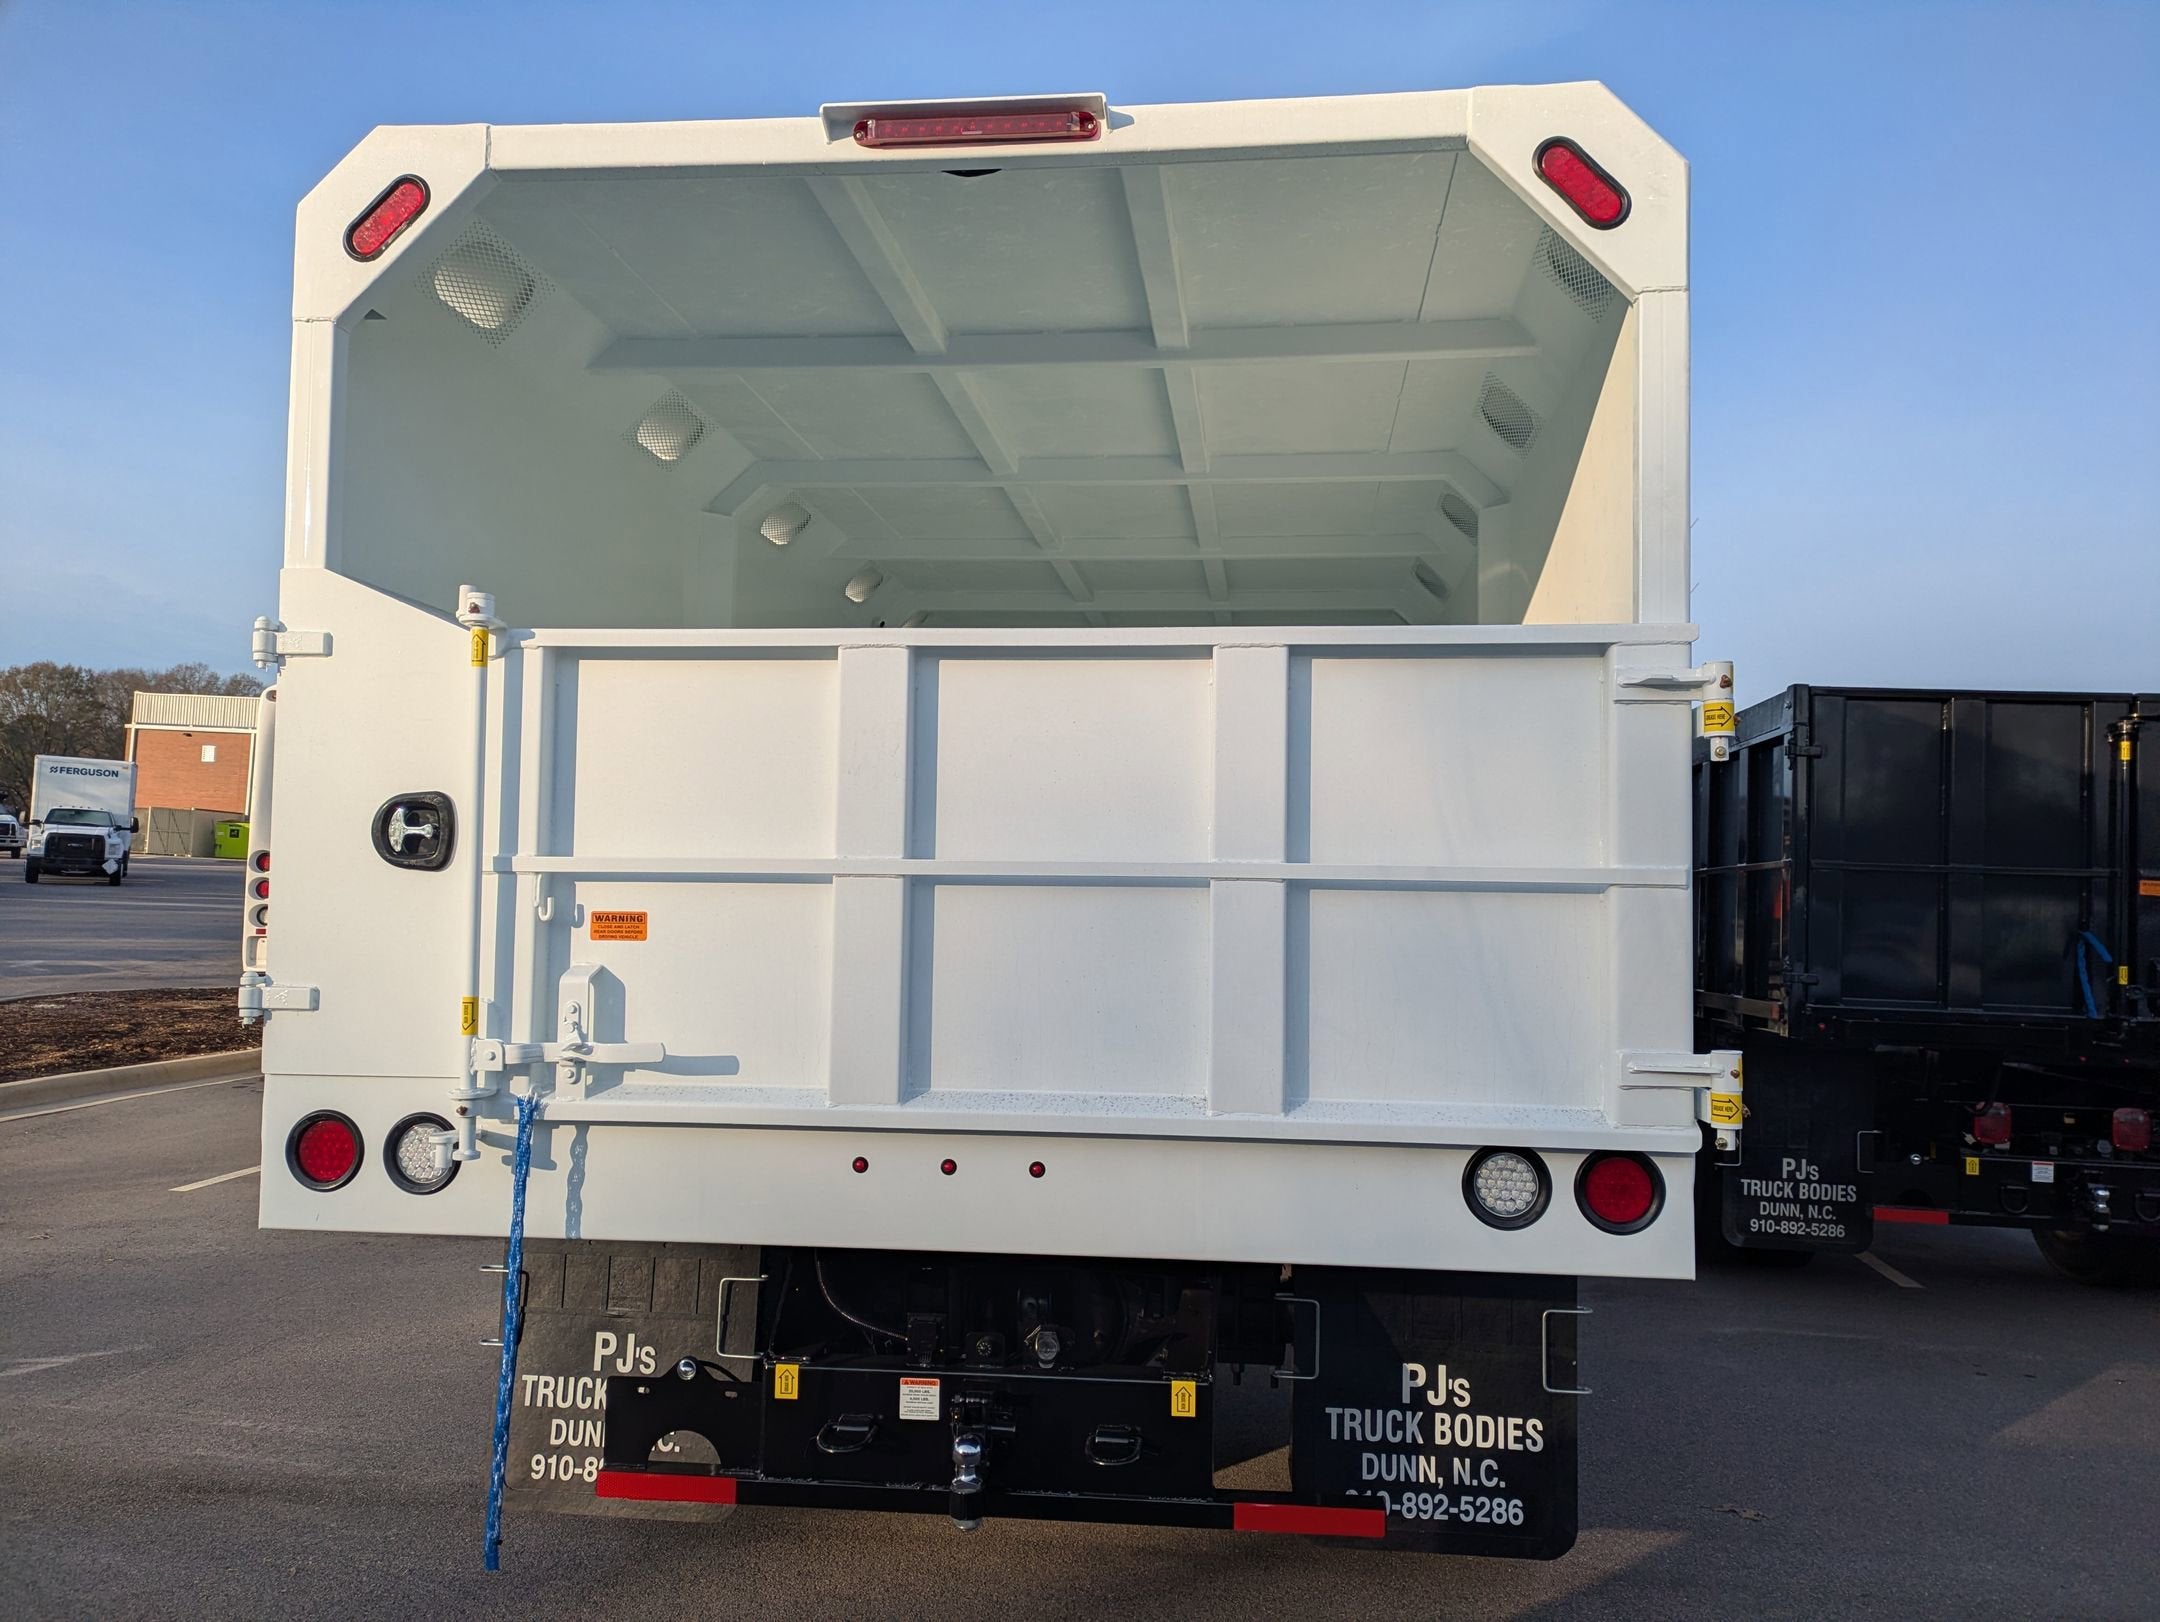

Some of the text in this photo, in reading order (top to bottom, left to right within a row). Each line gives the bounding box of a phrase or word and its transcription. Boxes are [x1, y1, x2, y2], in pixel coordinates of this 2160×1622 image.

[59, 766, 119, 778] FERGUSON
[594, 914, 644, 923] WARNING
[1740, 1179, 1857, 1203] TRUCK BODIES
[1759, 1201, 1837, 1220] DUNN, N.C.
[1750, 1218, 1846, 1238] 910-892-5286
[522, 1374, 608, 1410] TRUCK
[550, 1418, 605, 1448] DUN
[1325, 1407, 1544, 1453] TRUCK BODIES
[1361, 1452, 1506, 1489] DUNN, N.C.
